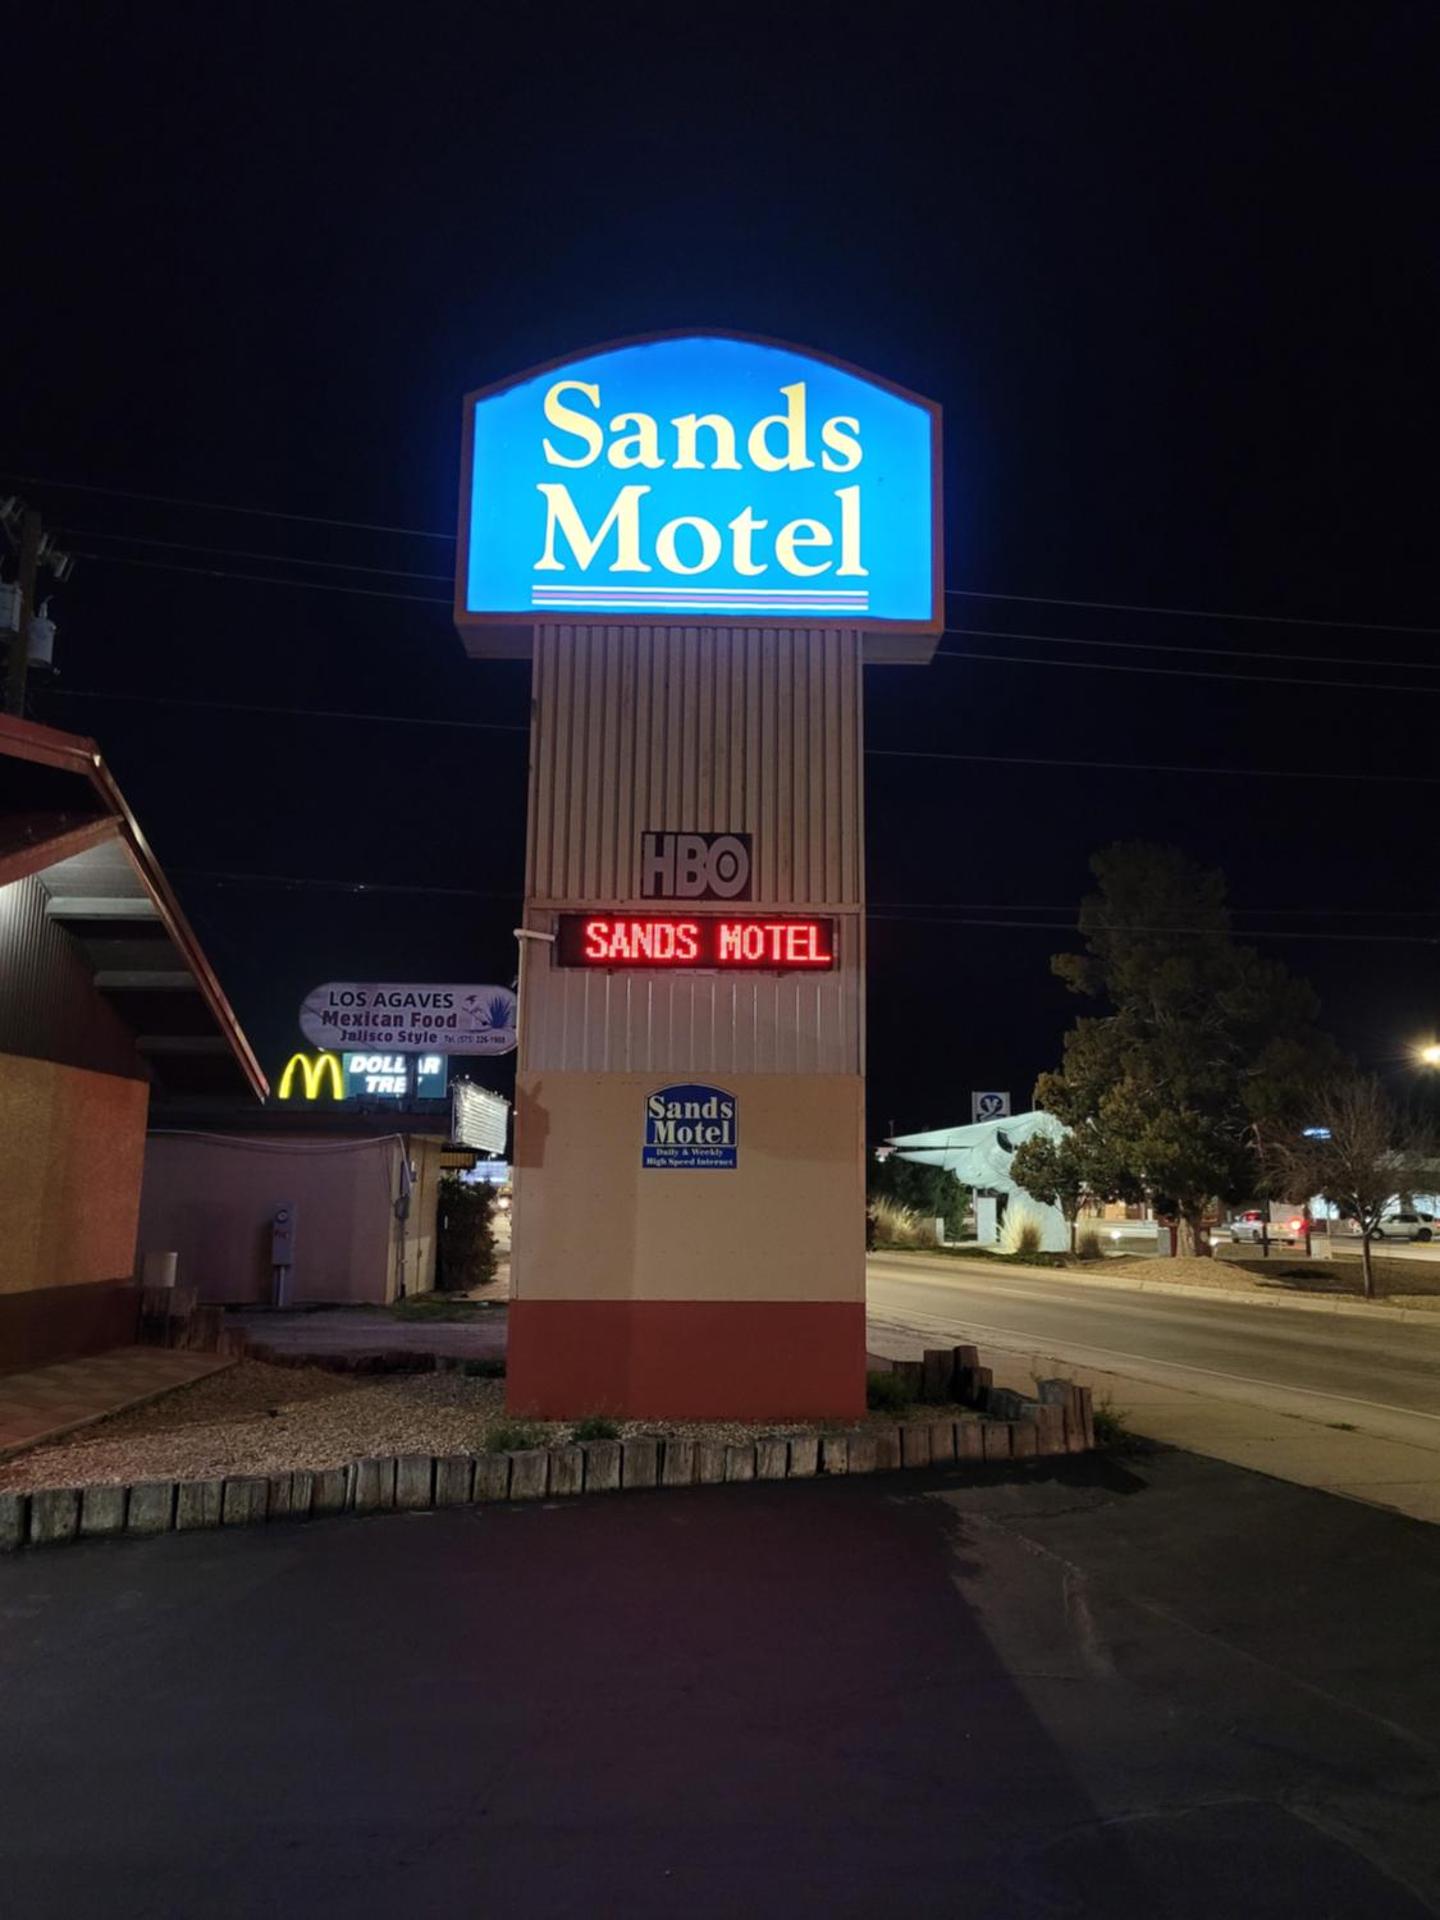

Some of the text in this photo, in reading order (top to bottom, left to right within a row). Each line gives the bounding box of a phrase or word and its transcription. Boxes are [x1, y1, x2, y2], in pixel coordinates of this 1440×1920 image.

[542, 379, 864, 473] Sands
[533, 483, 869, 577] Motel
[642, 833, 750, 898] HBO
[585, 922, 831, 961] SANDS MOTEL
[329, 991, 454, 1009] LOS AGAVES
[321, 1010, 457, 1029] Mexican Food
[340, 1029, 394, 1042] Jalisco
[398, 1030, 438, 1045] Style
[648, 1095, 734, 1119] Sands
[653, 1120, 730, 1144] Motel
[646, 1157, 734, 1167] High Speed Internet
[656, 1147, 679, 1158] Daily
[691, 1147, 724, 1158] Weekly
